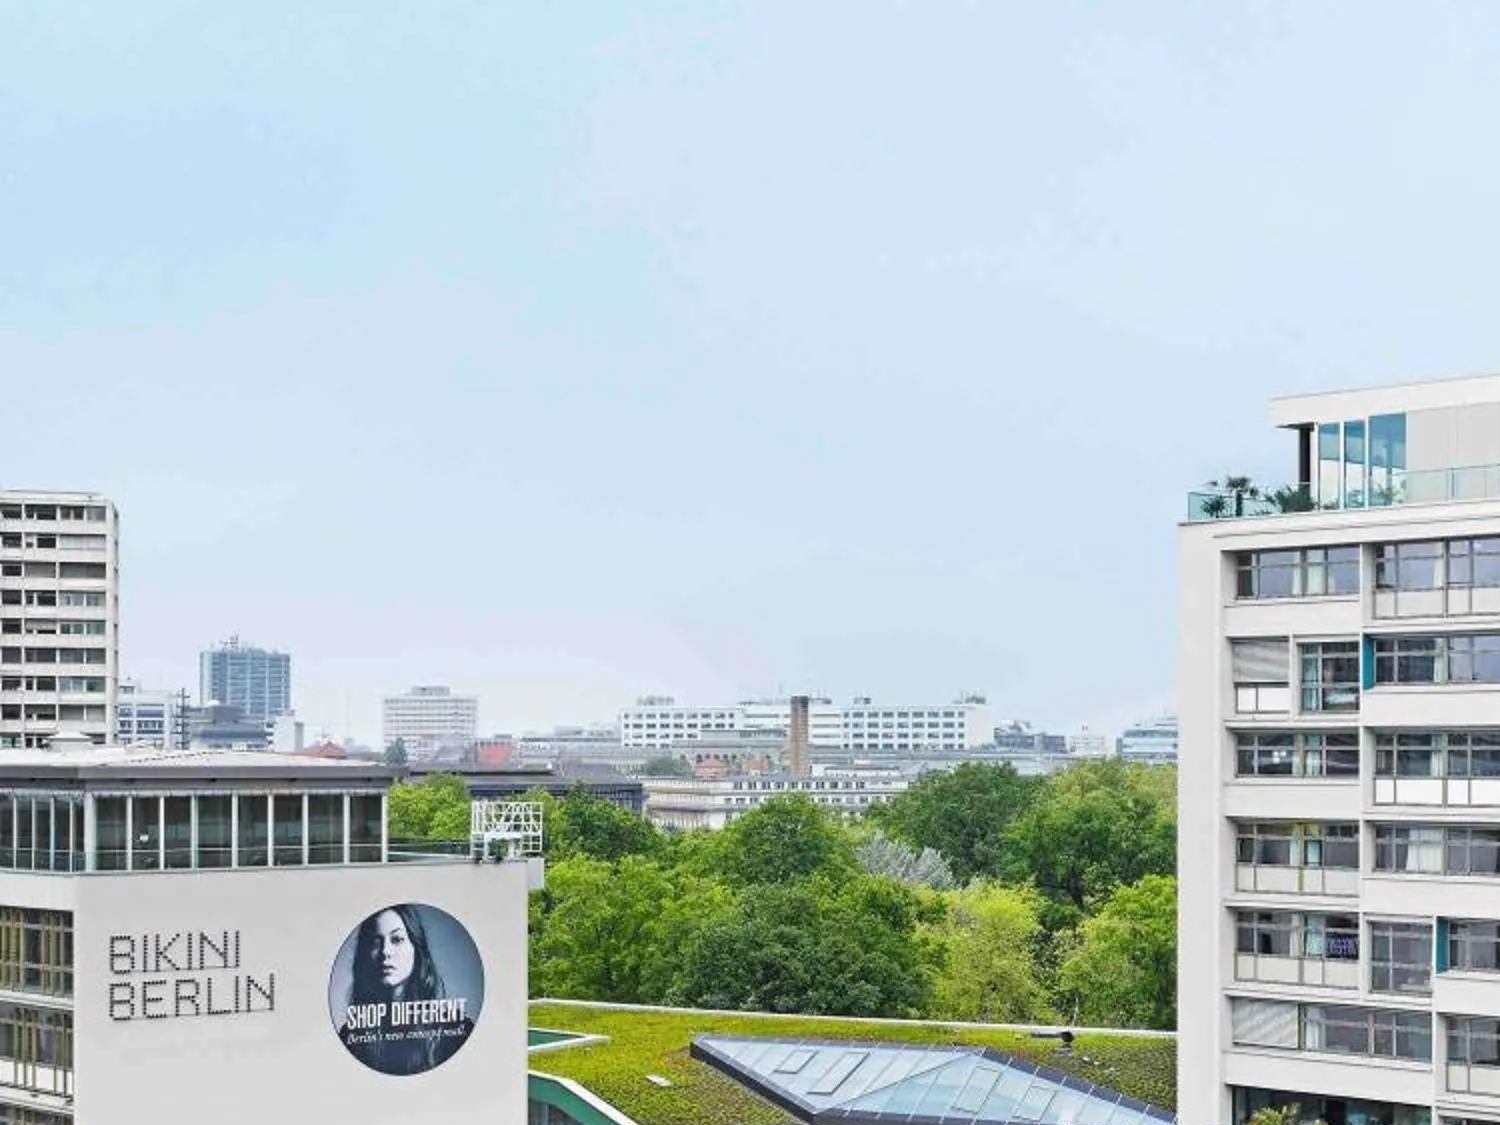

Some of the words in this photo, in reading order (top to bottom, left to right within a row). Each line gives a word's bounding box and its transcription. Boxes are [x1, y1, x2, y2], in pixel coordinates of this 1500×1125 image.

[109, 930, 240, 974] BIKINI
[109, 973, 275, 1021] BERLIN
[347, 1003, 387, 1030] SHOP
[391, 998, 468, 1027] DIFFERENT
